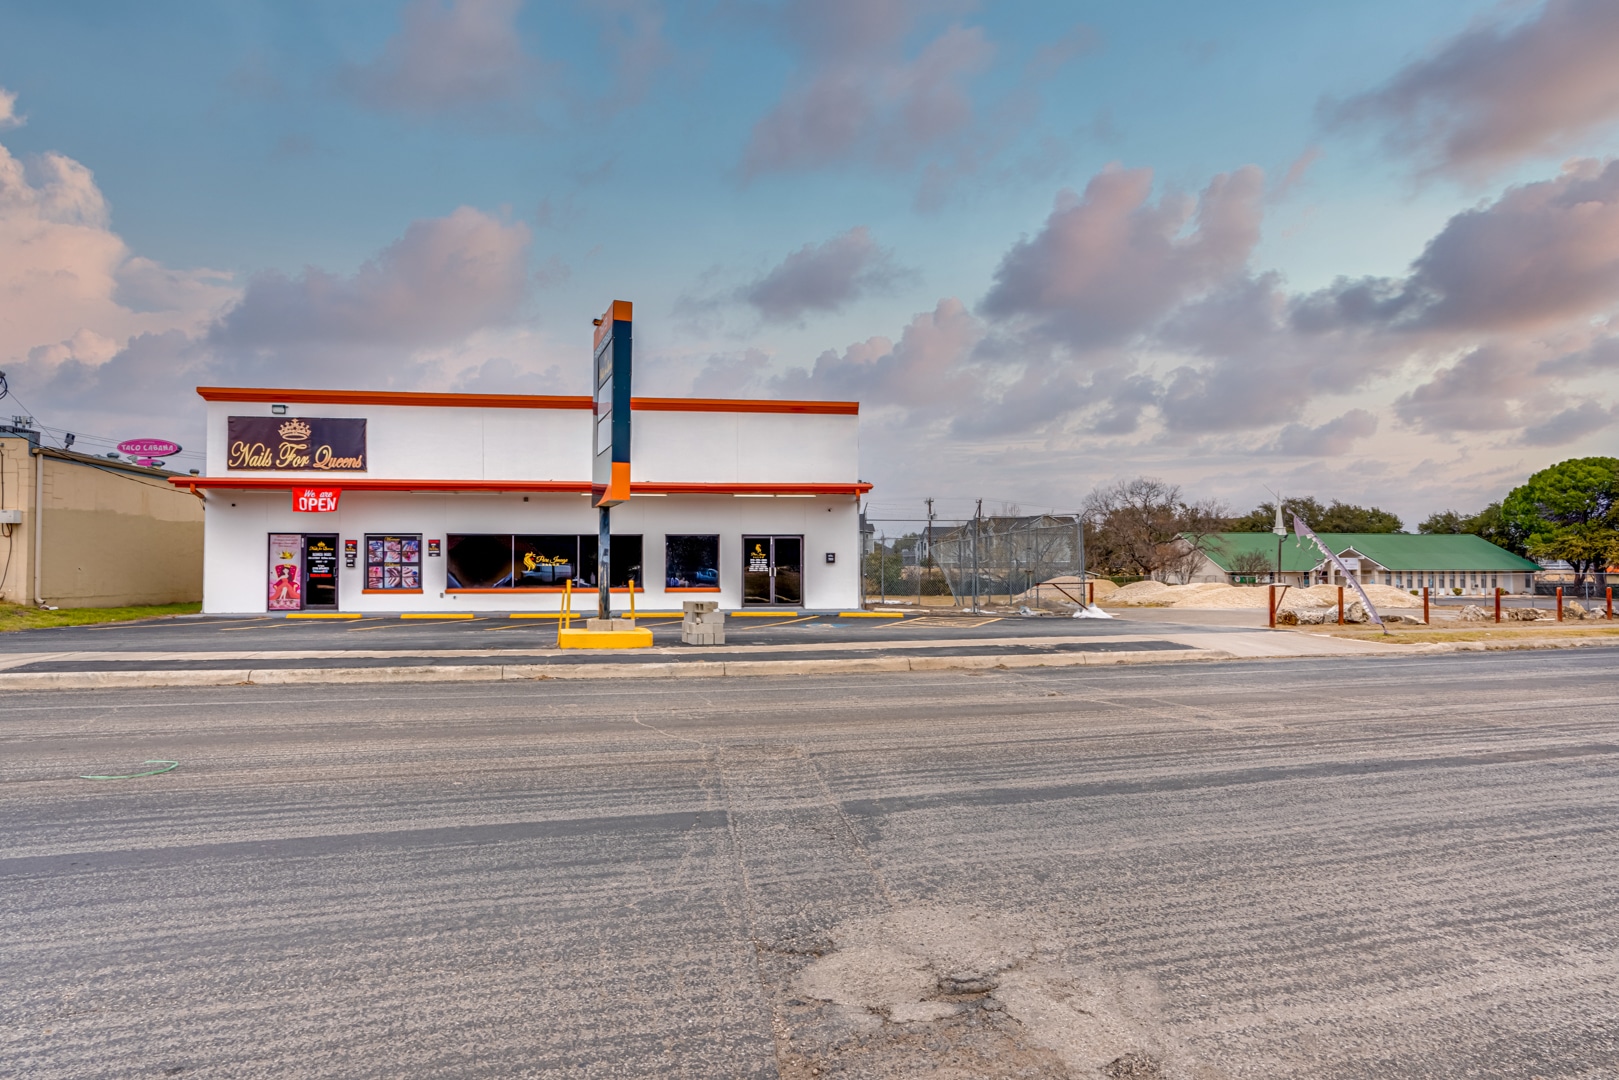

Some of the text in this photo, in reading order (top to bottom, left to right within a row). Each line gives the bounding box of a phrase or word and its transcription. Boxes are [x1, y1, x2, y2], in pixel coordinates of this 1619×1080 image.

[228, 441, 363, 470] Nails For Queens
[304, 489, 316, 498] We
[298, 497, 337, 512] OPEN
